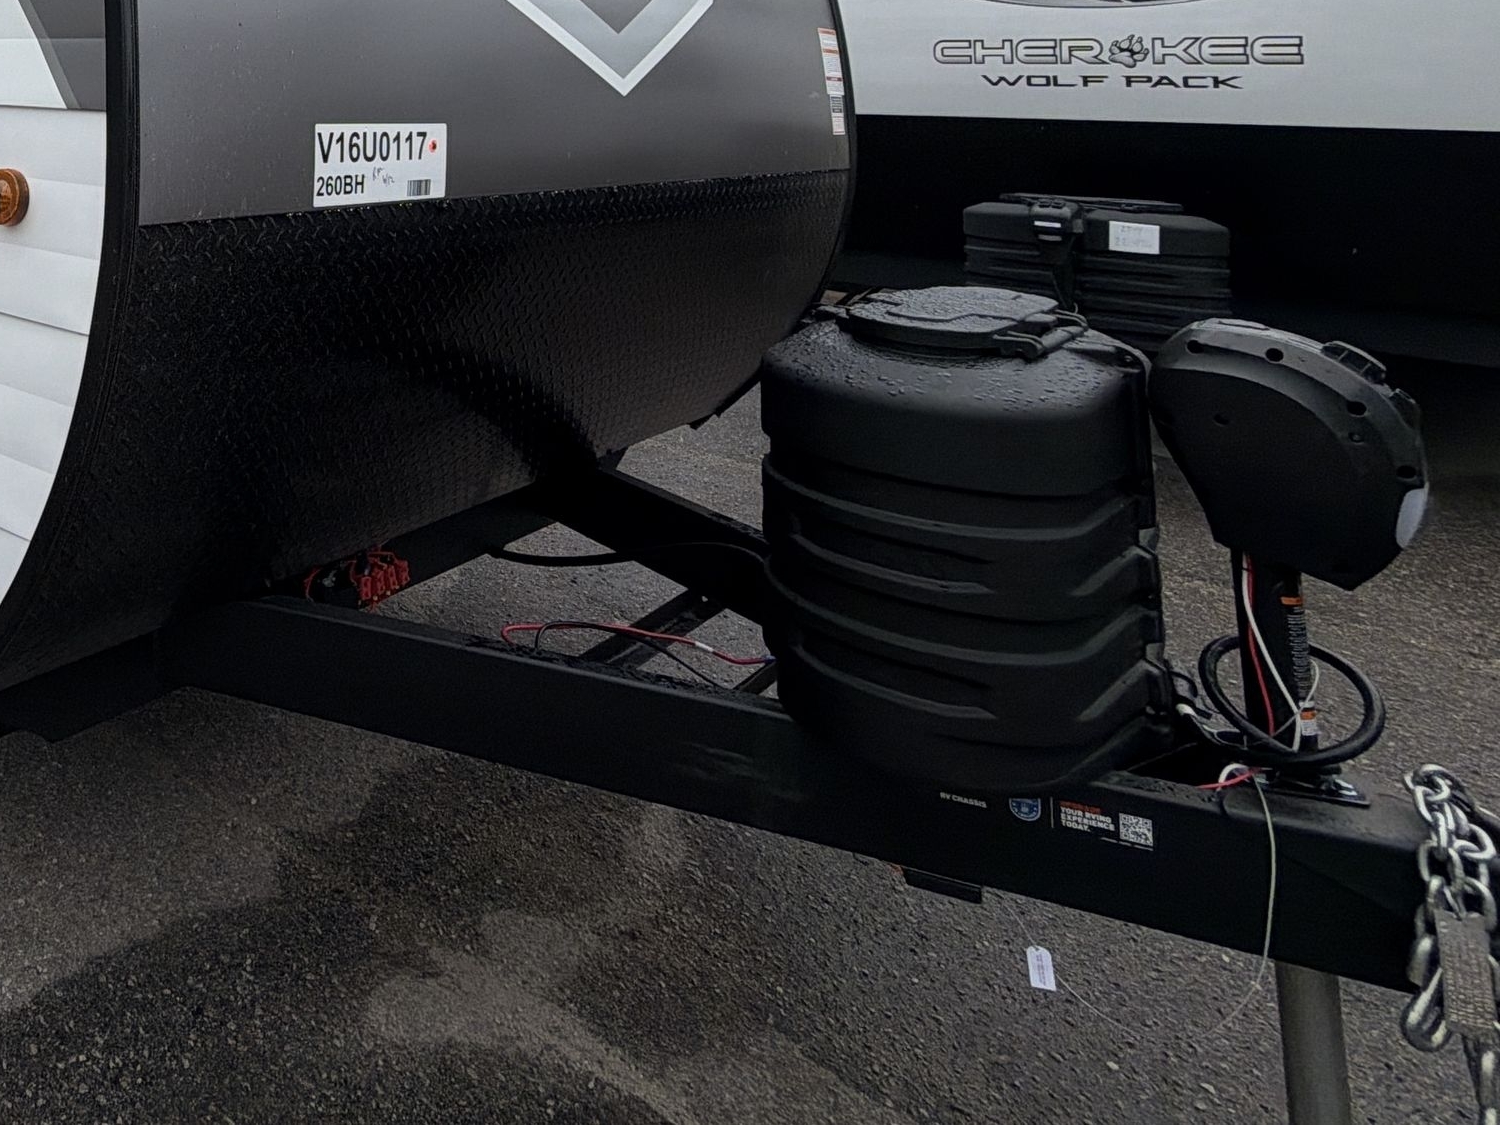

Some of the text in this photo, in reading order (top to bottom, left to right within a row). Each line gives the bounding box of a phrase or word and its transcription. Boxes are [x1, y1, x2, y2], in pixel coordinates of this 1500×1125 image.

[981, 74, 1243, 90] WOLF PACK
[317, 131, 428, 164] V16U0117
[316, 173, 366, 197] 260BH
[1060, 806, 1084, 818] YOUR
[1084, 811, 1112, 824] RVING
[1060, 813, 1116, 832] EXPERIENCE
